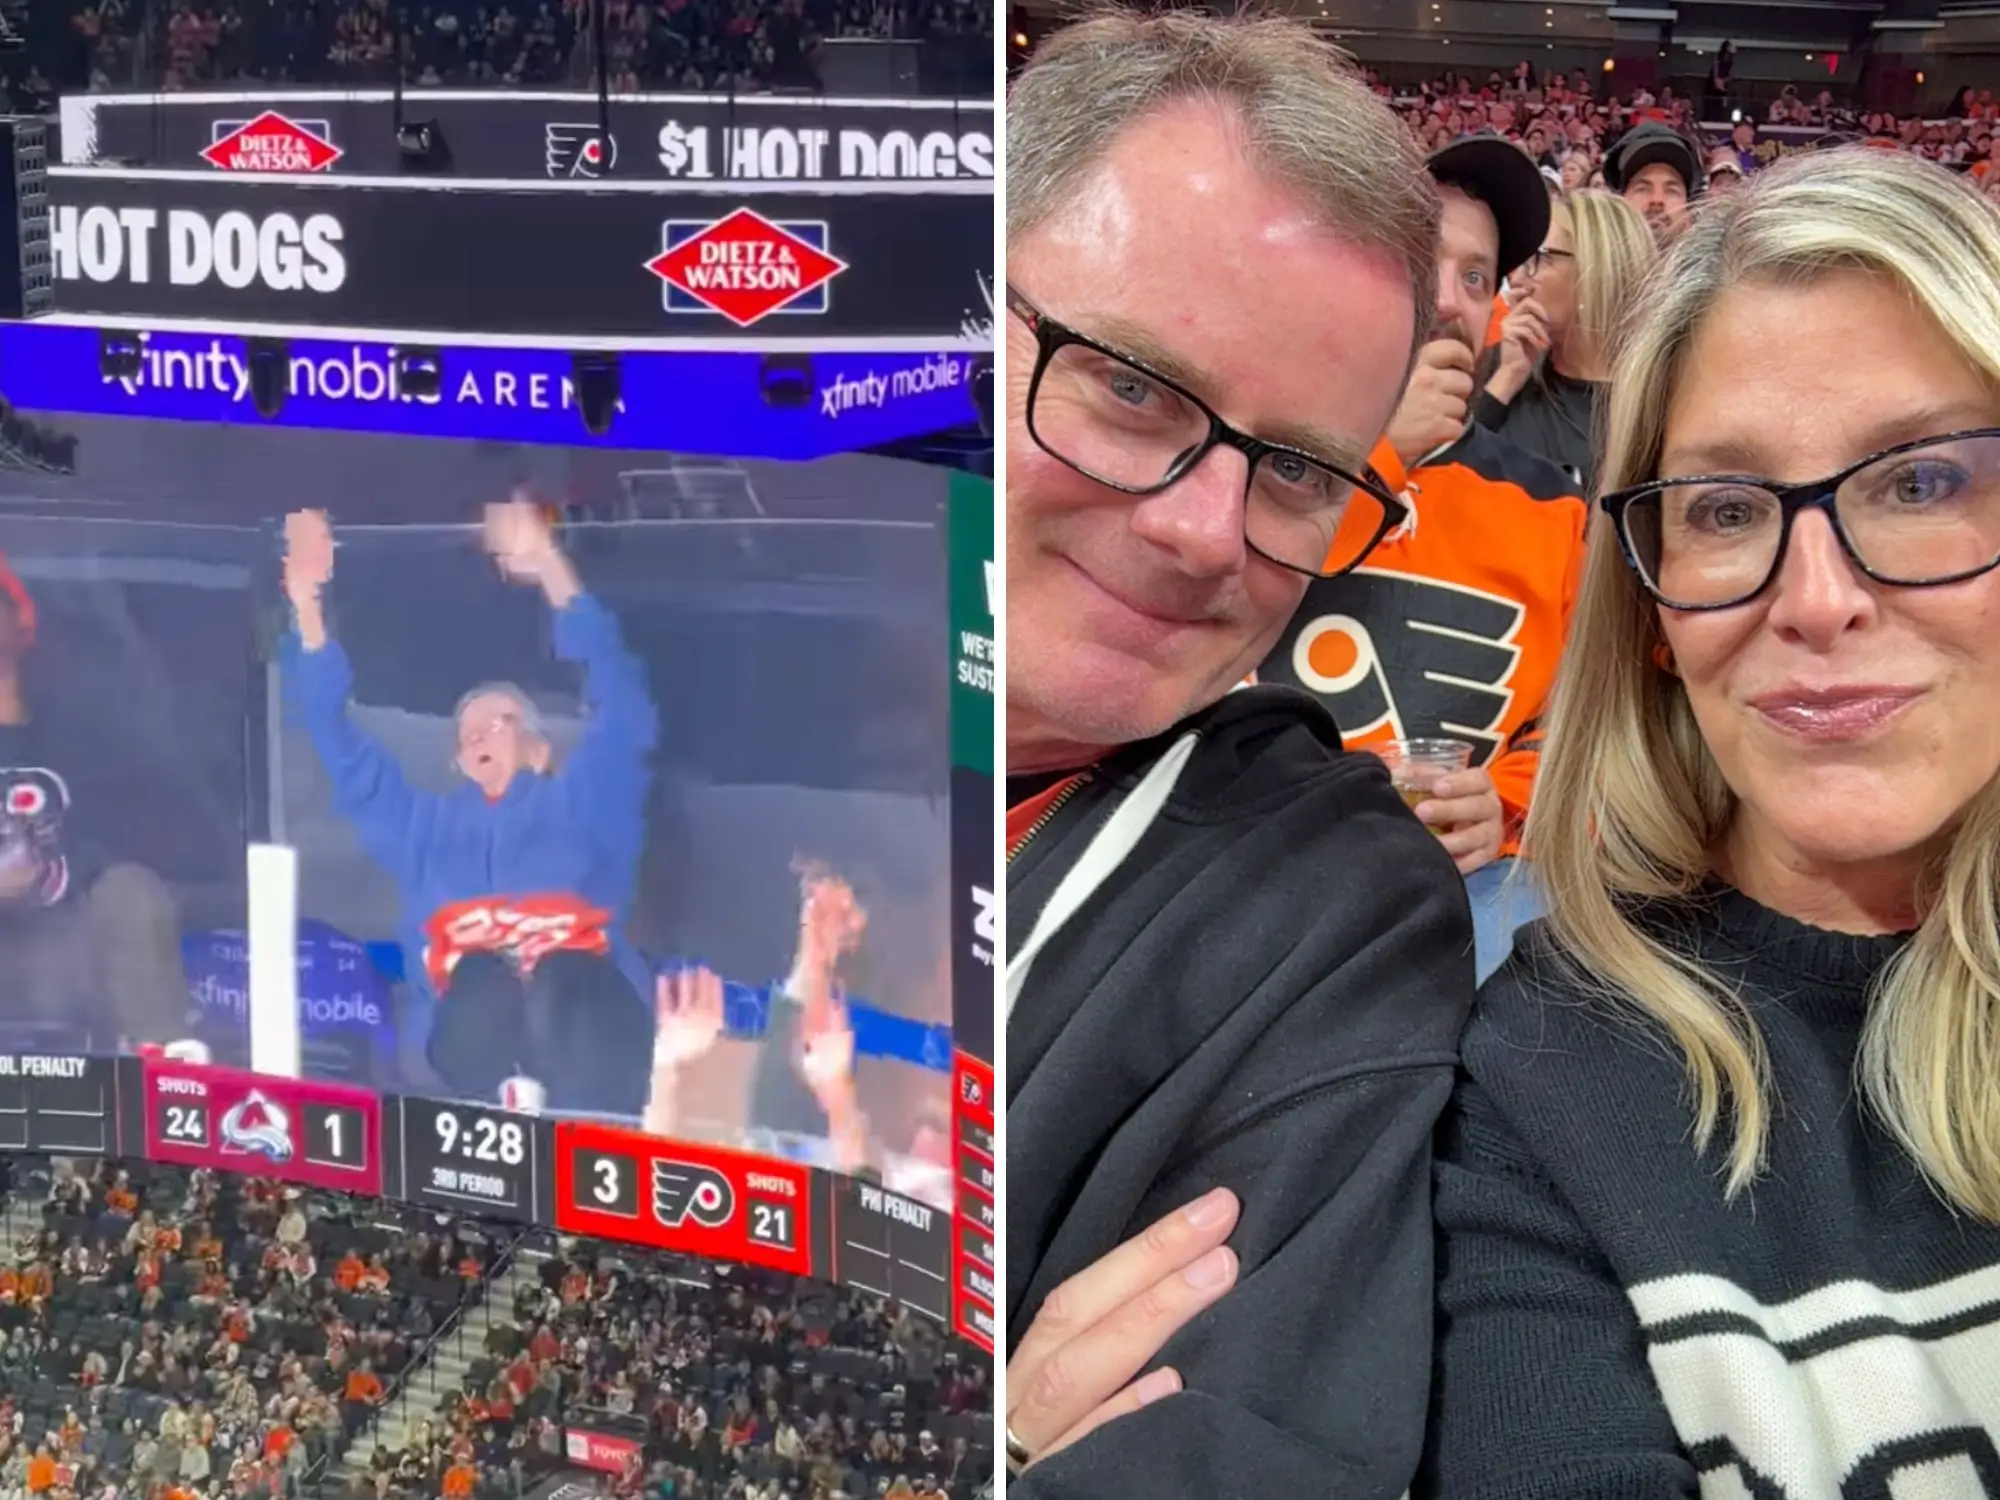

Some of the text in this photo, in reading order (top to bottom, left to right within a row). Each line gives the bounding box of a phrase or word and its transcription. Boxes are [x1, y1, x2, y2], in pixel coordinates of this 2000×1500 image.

[229, 152, 312, 171] WATSON
[658, 120, 994, 178] $1 HOT DOGS
[48, 206, 346, 292] HOT DOGS
[684, 265, 800, 290] WATSON
[821, 370, 889, 419] xfinity
[892, 351, 960, 399] mobile
[21, 1056, 86, 1078] PENALTY
[157, 1075, 207, 1097] SHOTS
[166, 1106, 202, 1138] 24
[323, 1114, 342, 1157] 1
[435, 1111, 524, 1165] 9:28
[432, 1167, 505, 1197] 3RD PERIOD
[592, 1159, 620, 1203] 3
[745, 1171, 797, 1197] SHOTS
[754, 1204, 786, 1241] 21
